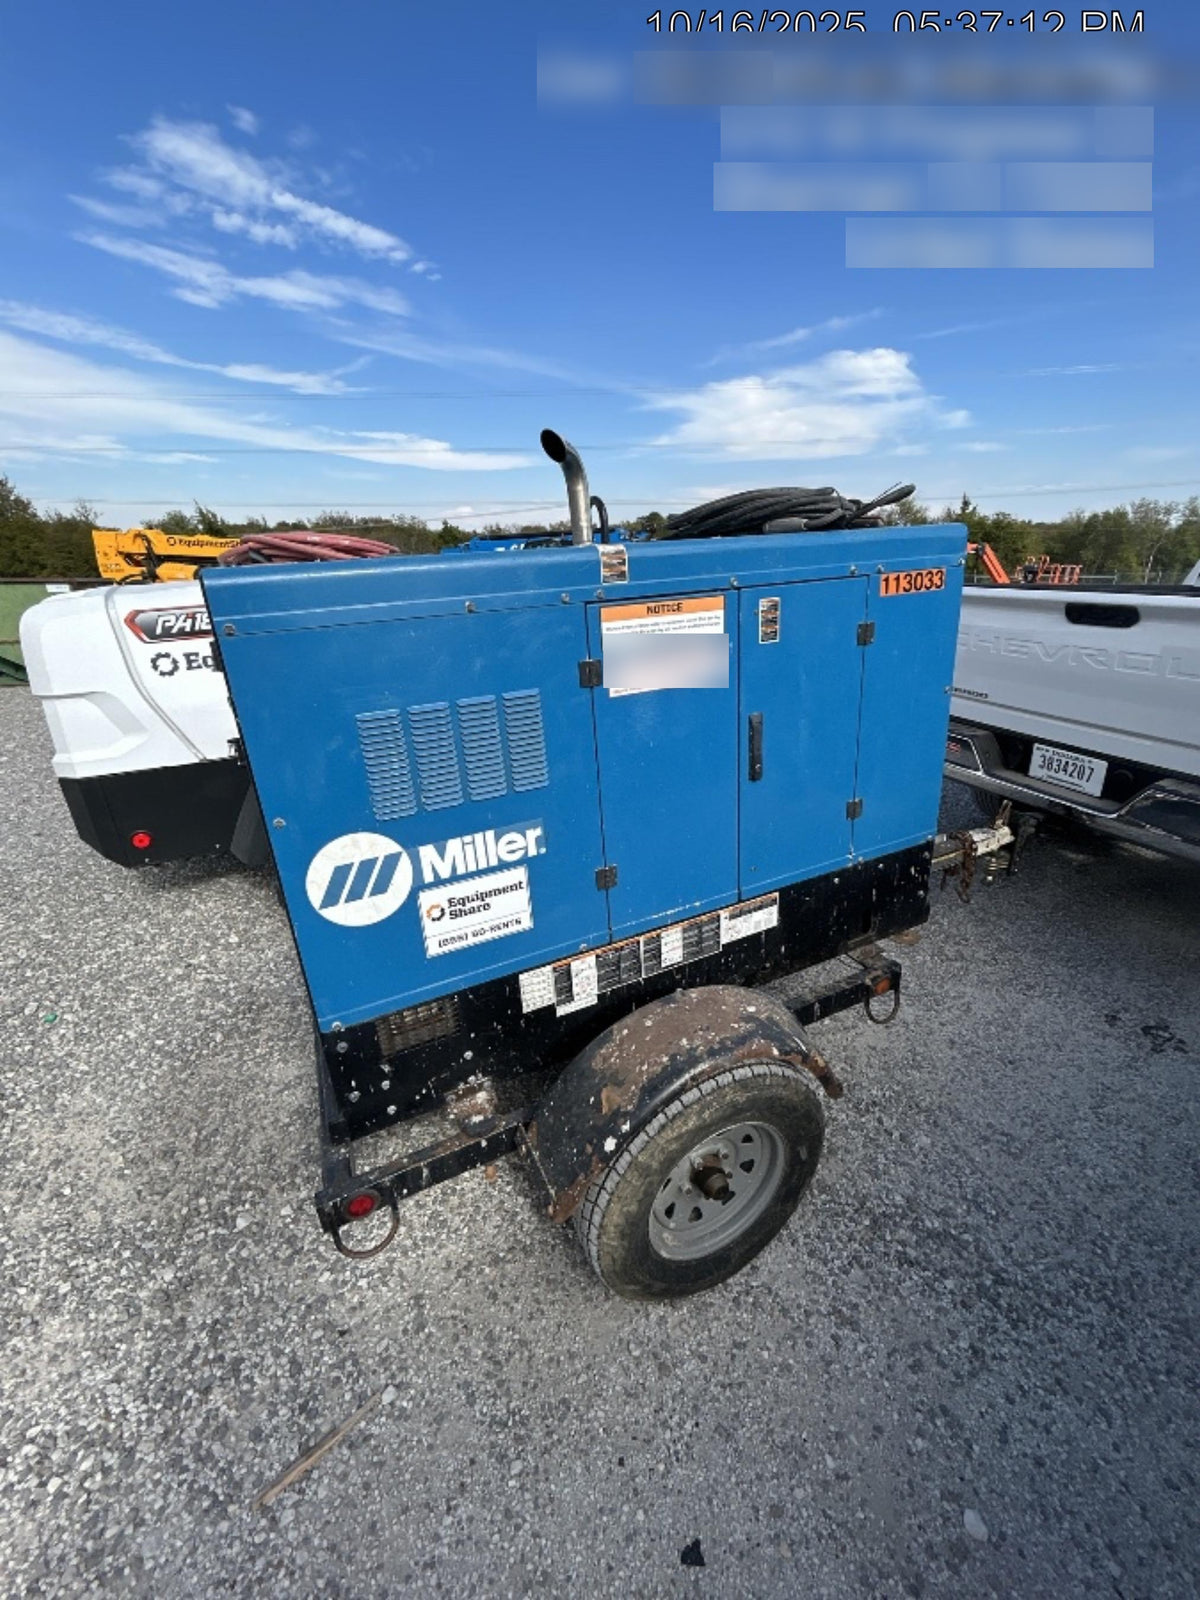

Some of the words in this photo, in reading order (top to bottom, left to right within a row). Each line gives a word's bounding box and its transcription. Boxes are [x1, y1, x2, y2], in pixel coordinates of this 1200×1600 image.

[882, 570, 943, 594] 113033
[647, 602, 683, 614] NOTICE
[447, 881, 524, 909] Equipment
[448, 902, 492, 920] Share
